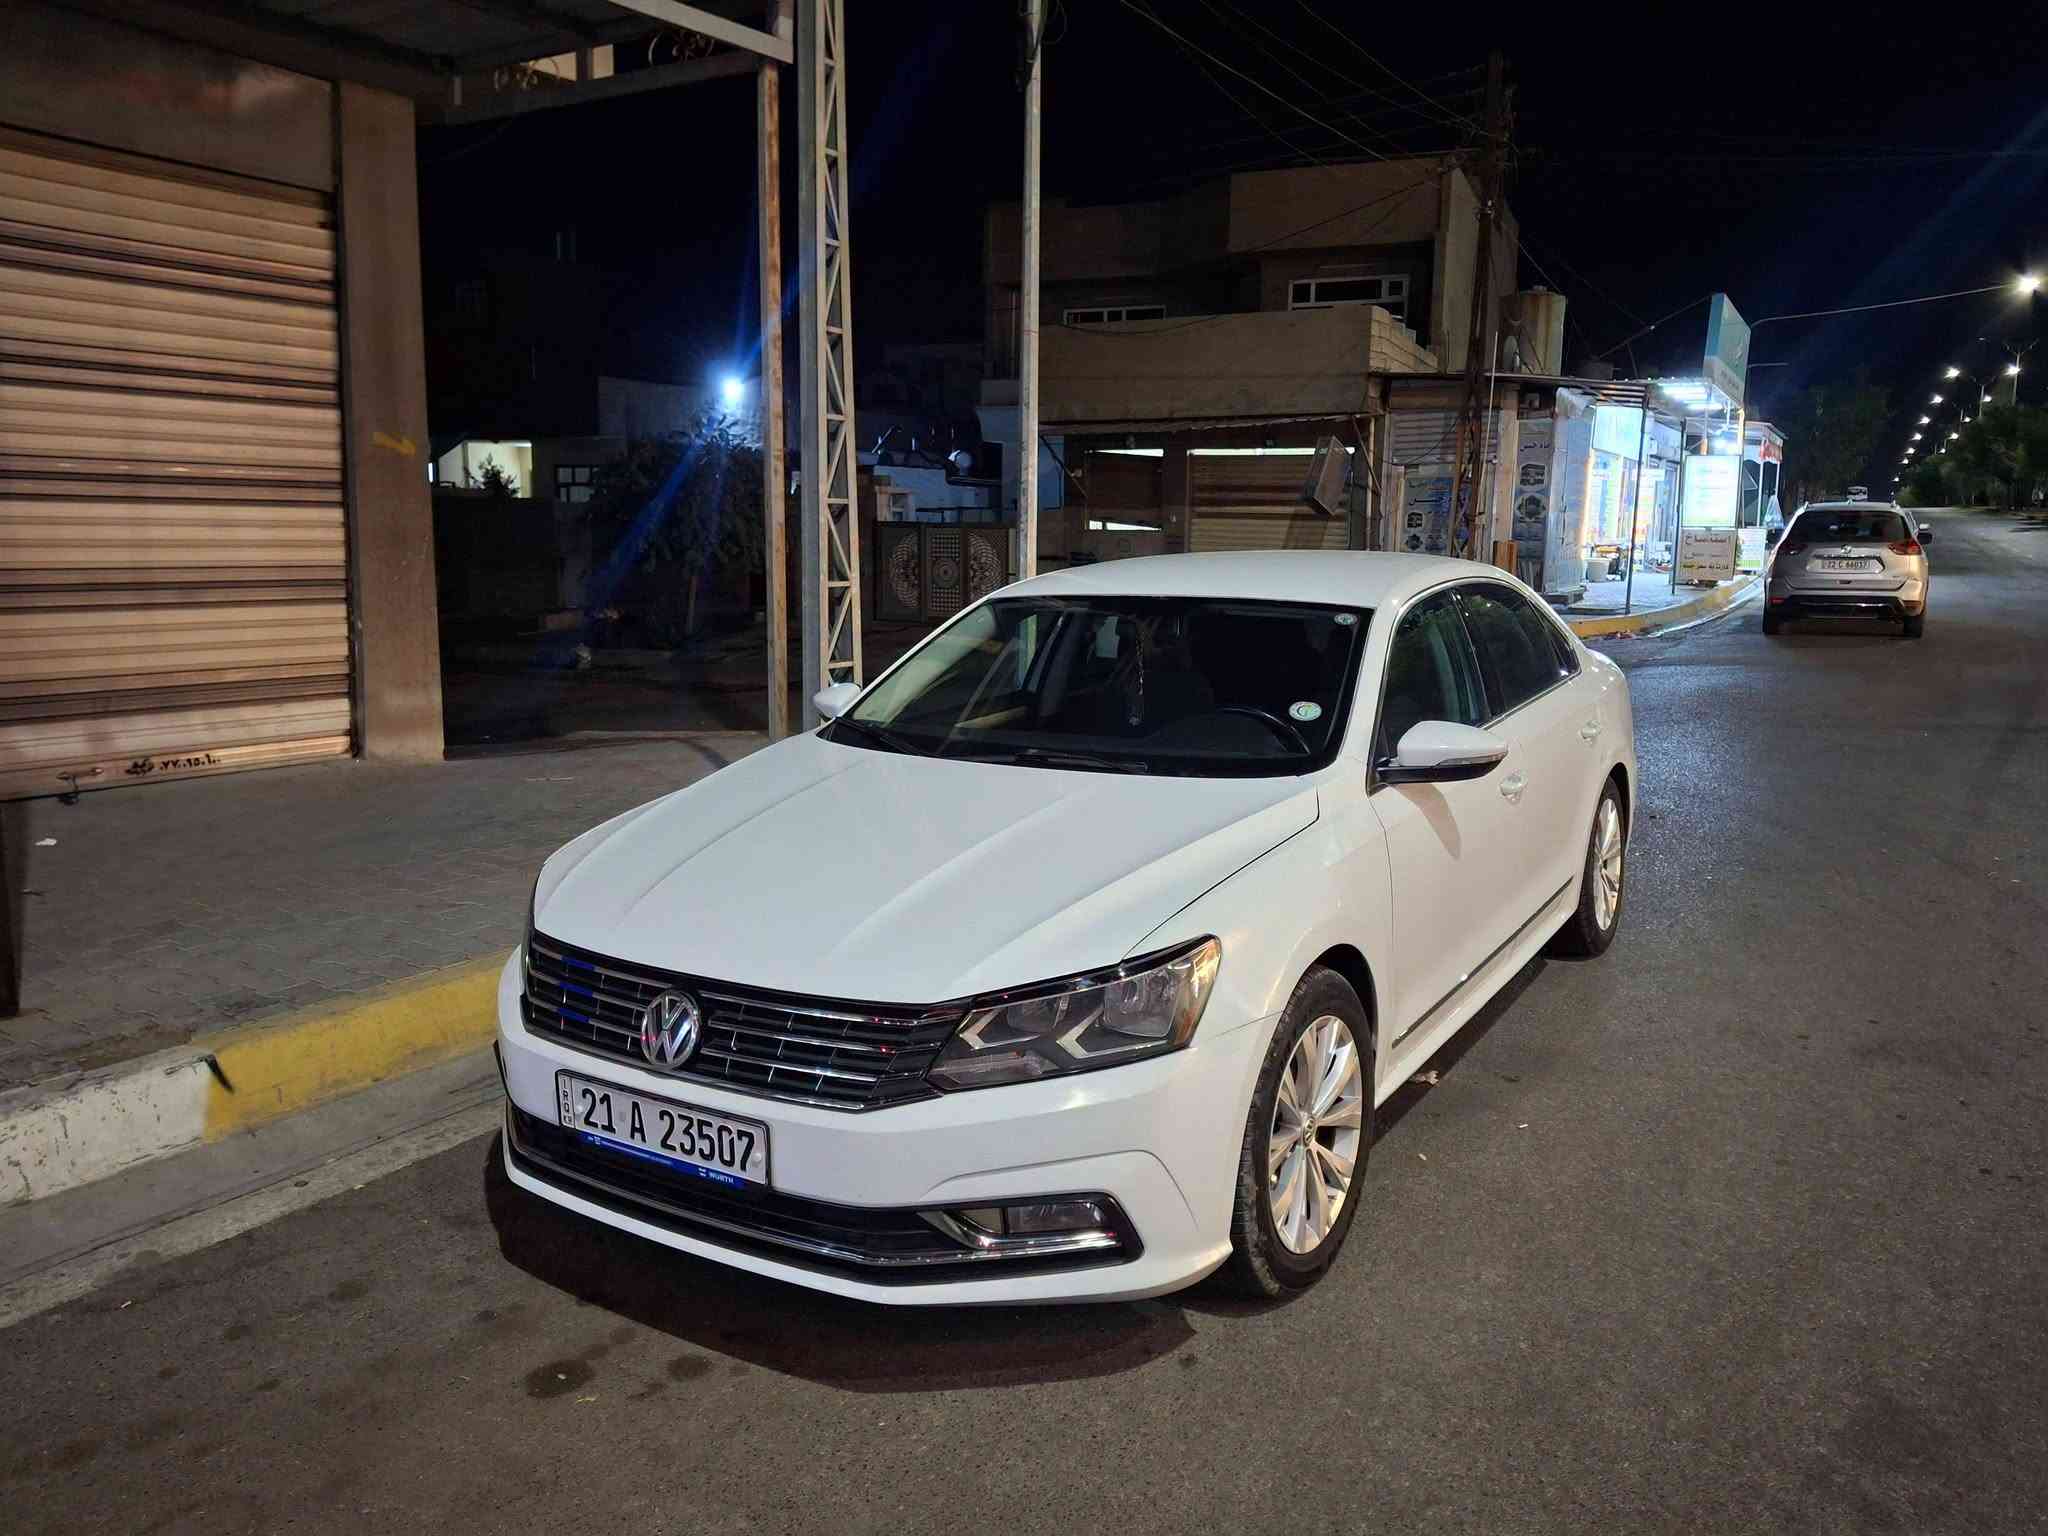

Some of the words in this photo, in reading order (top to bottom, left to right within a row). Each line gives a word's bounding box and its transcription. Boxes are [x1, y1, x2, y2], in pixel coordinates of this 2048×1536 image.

[581, 1087, 617, 1135] 21
[630, 1101, 647, 1143] A
[659, 1110, 756, 1172] 23507
